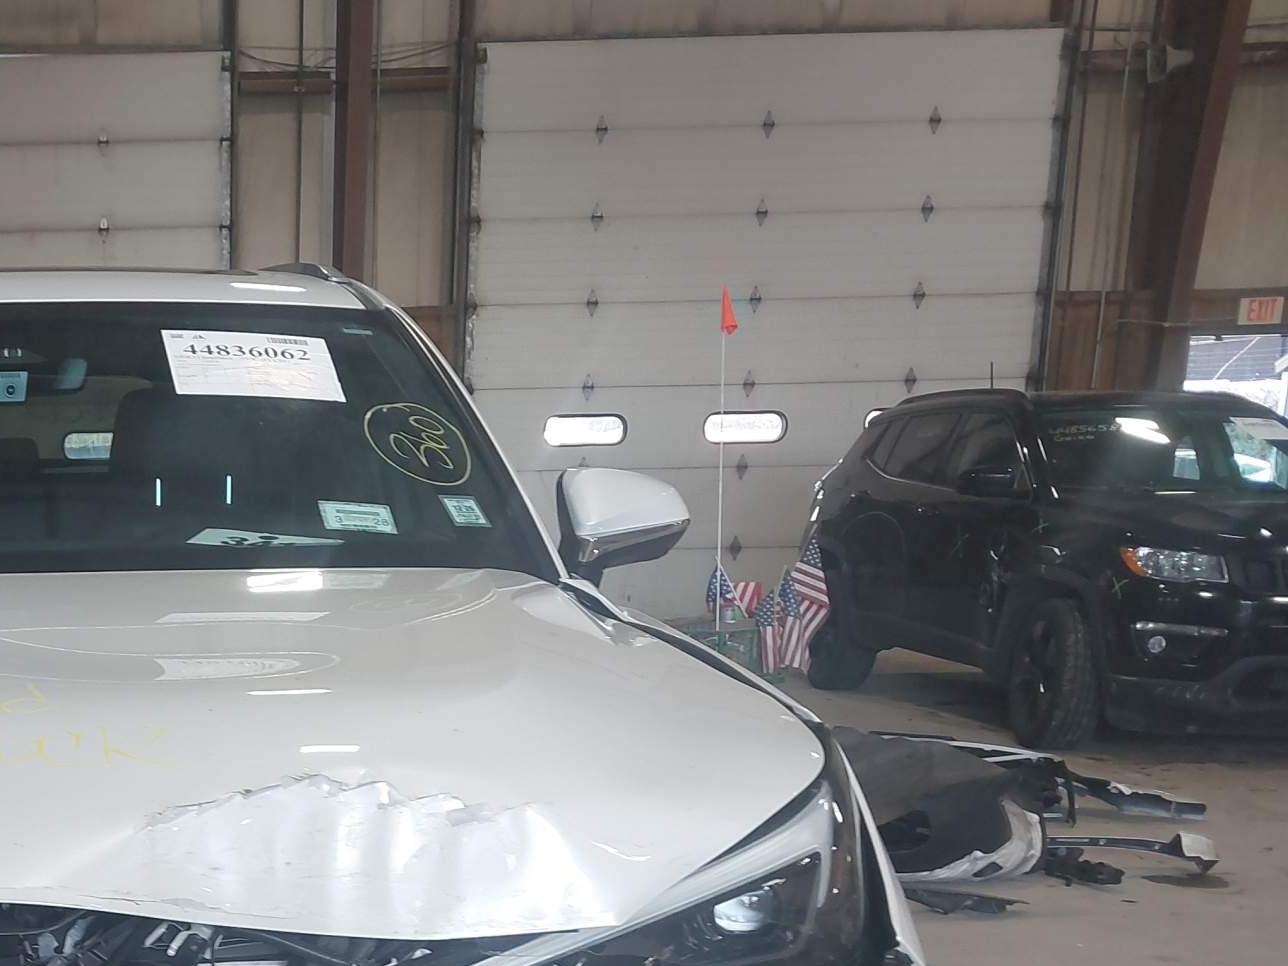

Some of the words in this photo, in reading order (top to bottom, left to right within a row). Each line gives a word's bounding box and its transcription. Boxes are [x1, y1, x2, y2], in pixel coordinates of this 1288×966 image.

[1247, 298, 1278, 322] EXIT
[183, 343, 311, 361] 44836062
[388, 415, 454, 470] 360
